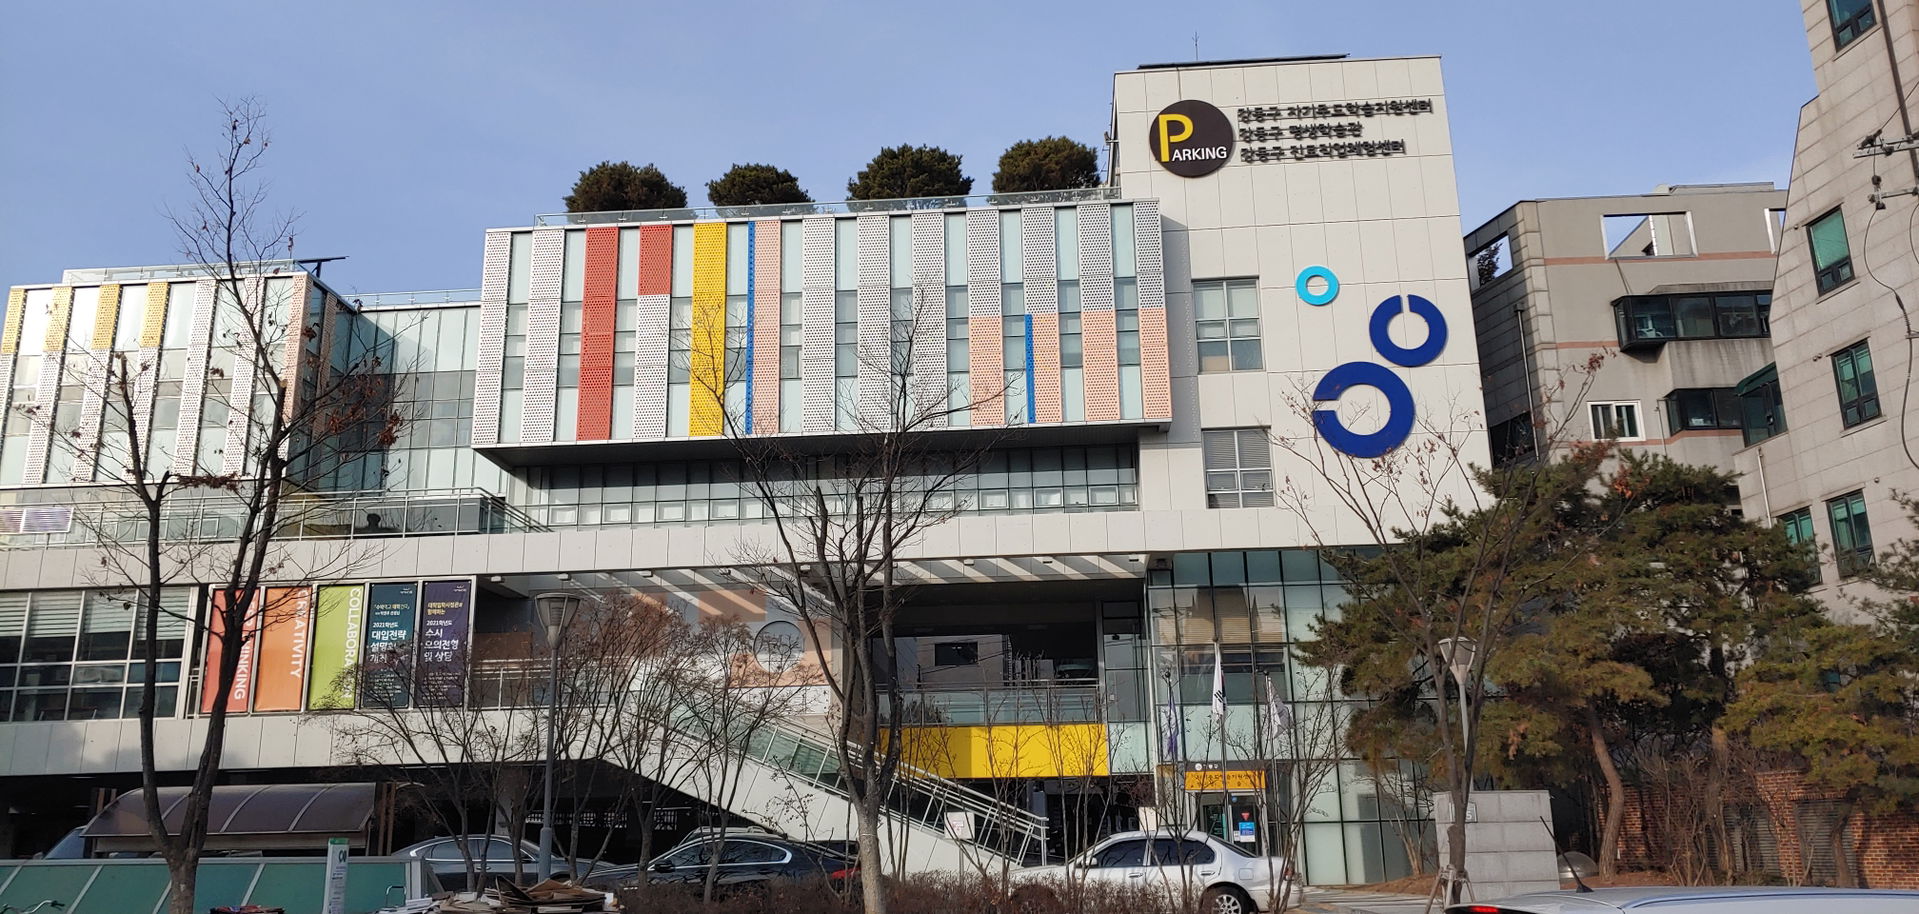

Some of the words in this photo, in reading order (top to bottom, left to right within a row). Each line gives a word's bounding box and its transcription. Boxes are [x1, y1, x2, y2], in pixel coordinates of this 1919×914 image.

[1237, 105, 1281, 124] 강동구
[1287, 98, 1433, 120] 자기주도학습지원센터
[1158, 113, 1227, 163] PARKING
[1239, 126, 1283, 143] 강동구
[1289, 121, 1363, 141] 평생학습관
[1241, 145, 1285, 164] 강동구
[1290, 138, 1406, 161] 진로직업체험센터
[371, 629, 407, 641] 대입전략
[425, 628, 443, 638] 수시
